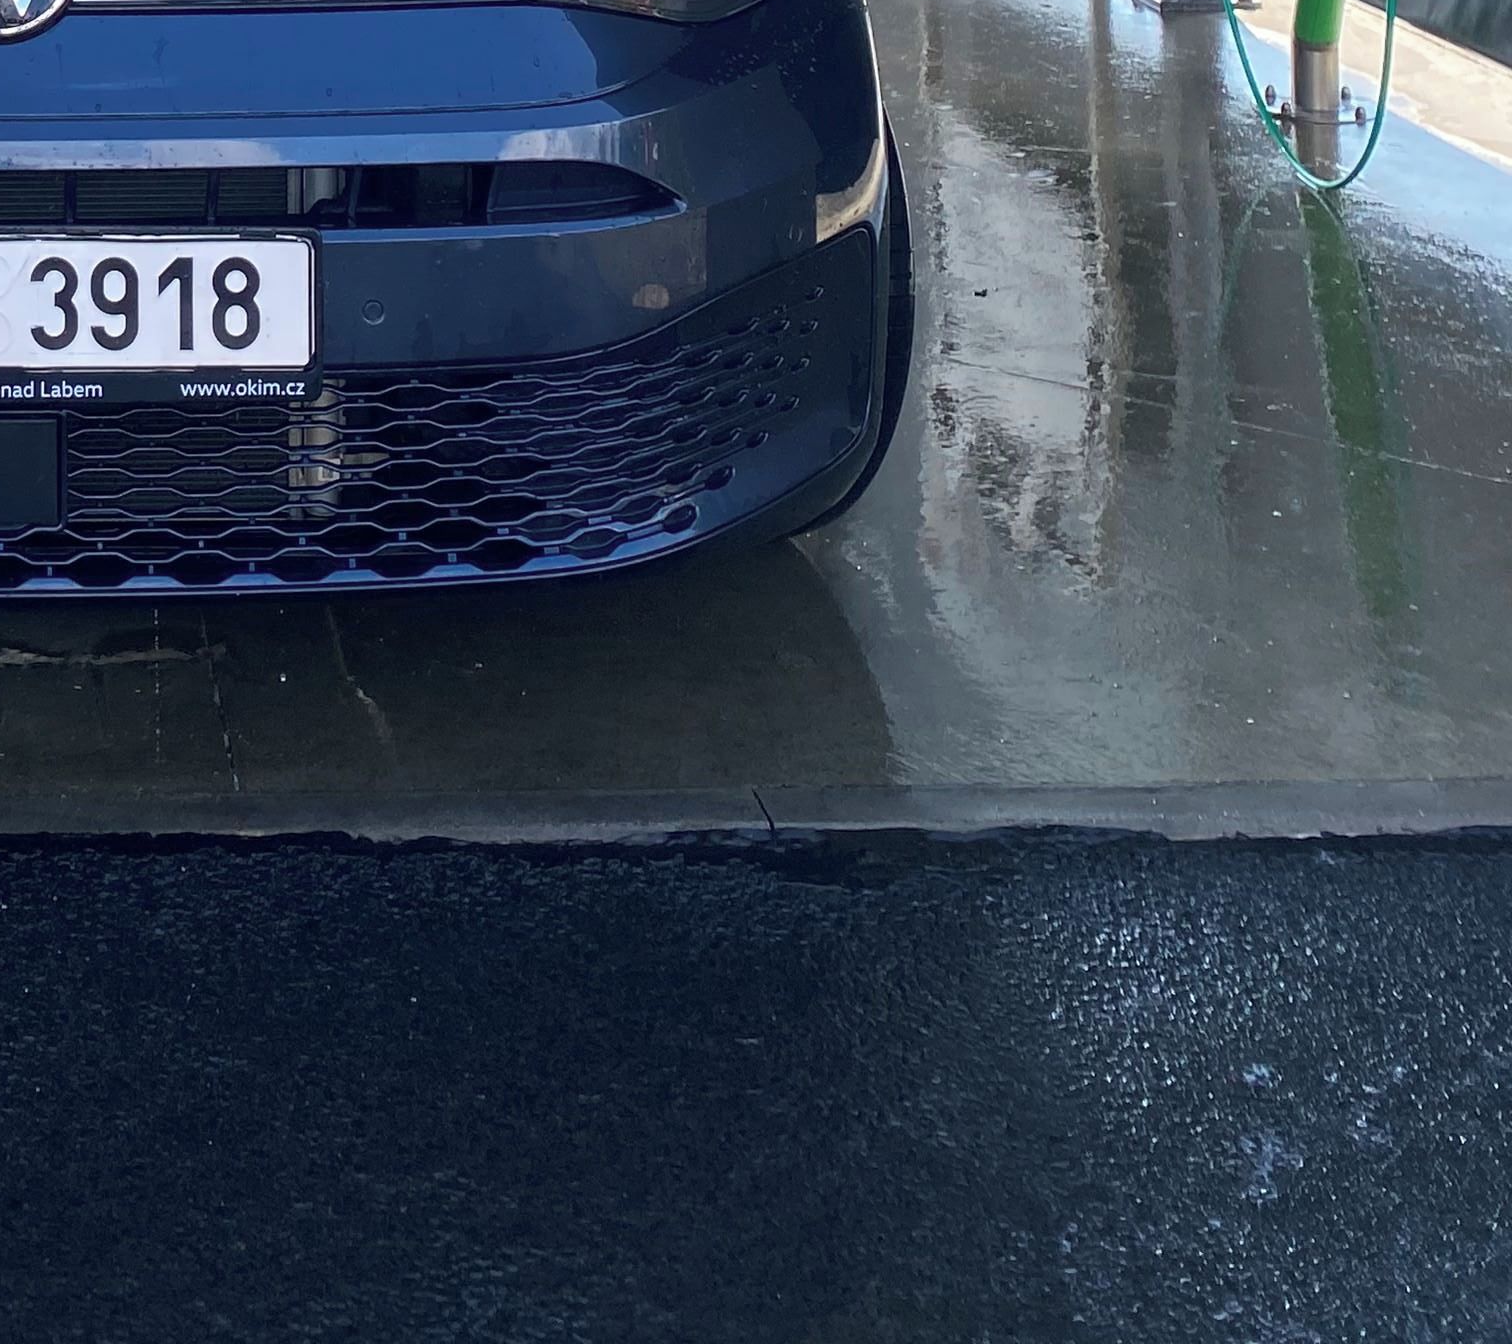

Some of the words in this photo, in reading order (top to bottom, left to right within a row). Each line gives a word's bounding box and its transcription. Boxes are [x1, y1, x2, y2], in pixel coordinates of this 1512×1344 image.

[30, 256, 261, 351] 3918
[0, 380, 35, 399] nad
[40, 379, 103, 399] Labem
[180, 378, 306, 398] www.okim.cz
